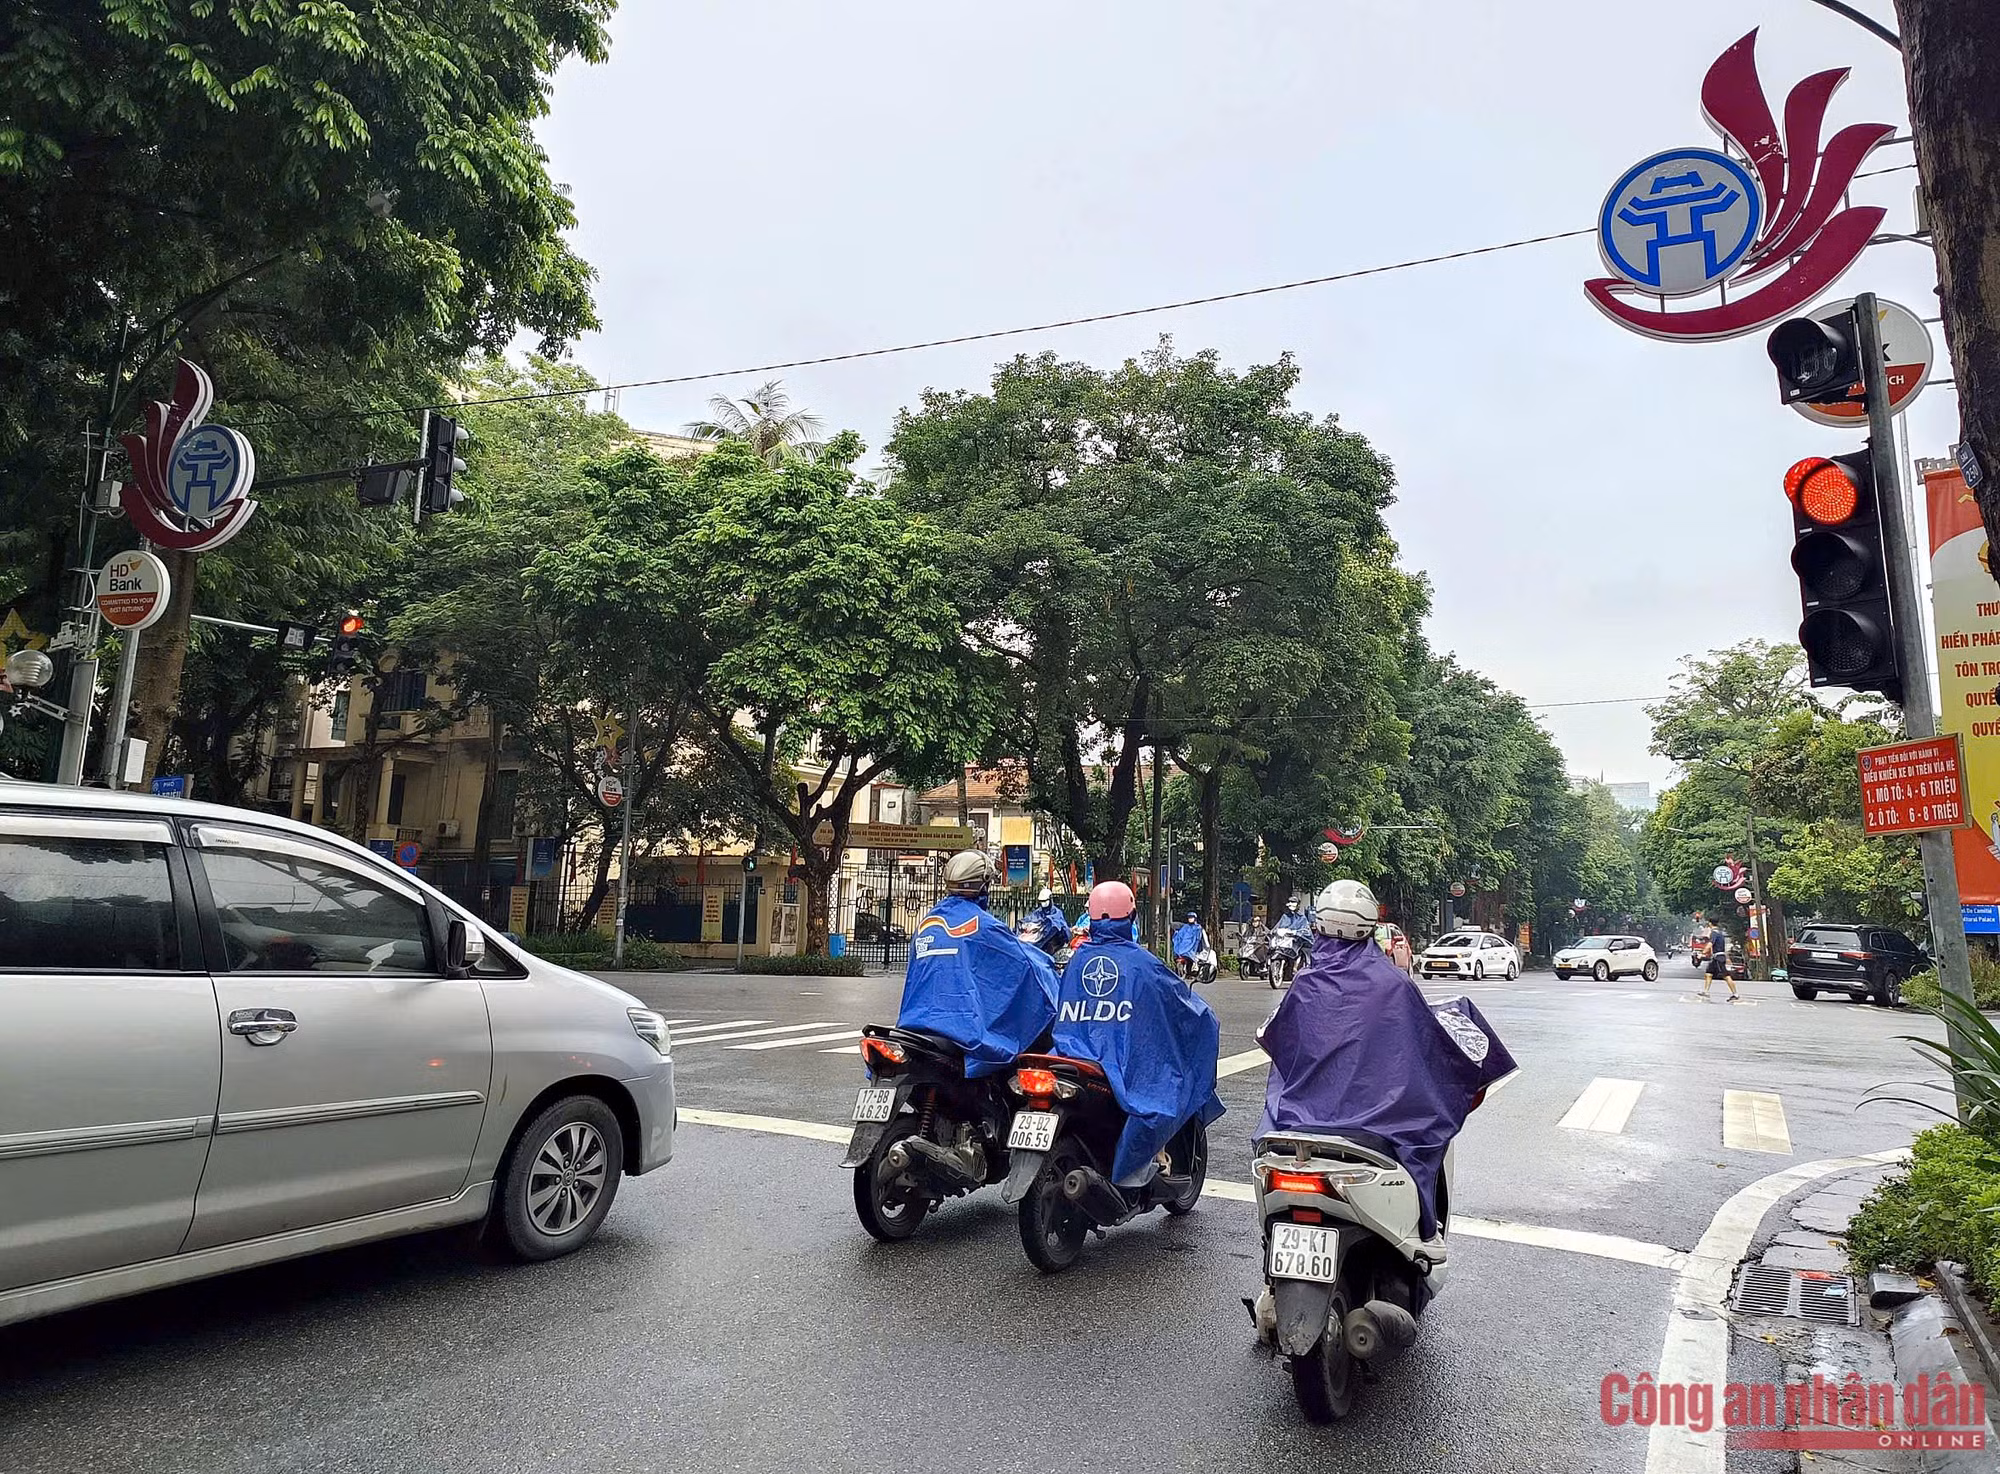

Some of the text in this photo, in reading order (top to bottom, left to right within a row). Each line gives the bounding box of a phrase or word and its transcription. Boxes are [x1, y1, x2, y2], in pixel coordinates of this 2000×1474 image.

[1966, 464, 1979, 482] 250
[110, 563, 129, 578] HD
[110, 577, 142, 591] Bank
[1976, 600, 2000, 617] THƯ
[1941, 630, 1969, 649] HIẾN
[1954, 661, 1979, 678] TÔN
[1898, 766, 1907, 779] XE
[1866, 790, 1875, 804] 1.
[1875, 784, 1890, 803] MÔ
[1891, 782, 1905, 800] TÔ:
[1907, 784, 1913, 799] 4
[1920, 782, 1927, 797] 6
[1929, 775, 1957, 798] TRIỆU
[1868, 812, 1877, 827] 2.
[1878, 808, 1884, 826] Ô
[1885, 806, 1900, 825] TÔ:
[1909, 807, 1915, 823] 6
[1923, 806, 1929, 821] 8
[1931, 800, 1959, 822] TRIỆU
[1059, 1000, 1133, 1022] NLDC
[863, 1090, 890, 1104] 17-B8
[855, 1104, 889, 1119] 146.29
[1018, 1115, 1051, 1132] 29-B2
[1010, 1131, 1050, 1148] 006.59
[1281, 1228, 1327, 1253] 29-K1
[1274, 1251, 1332, 1278] 678.60
